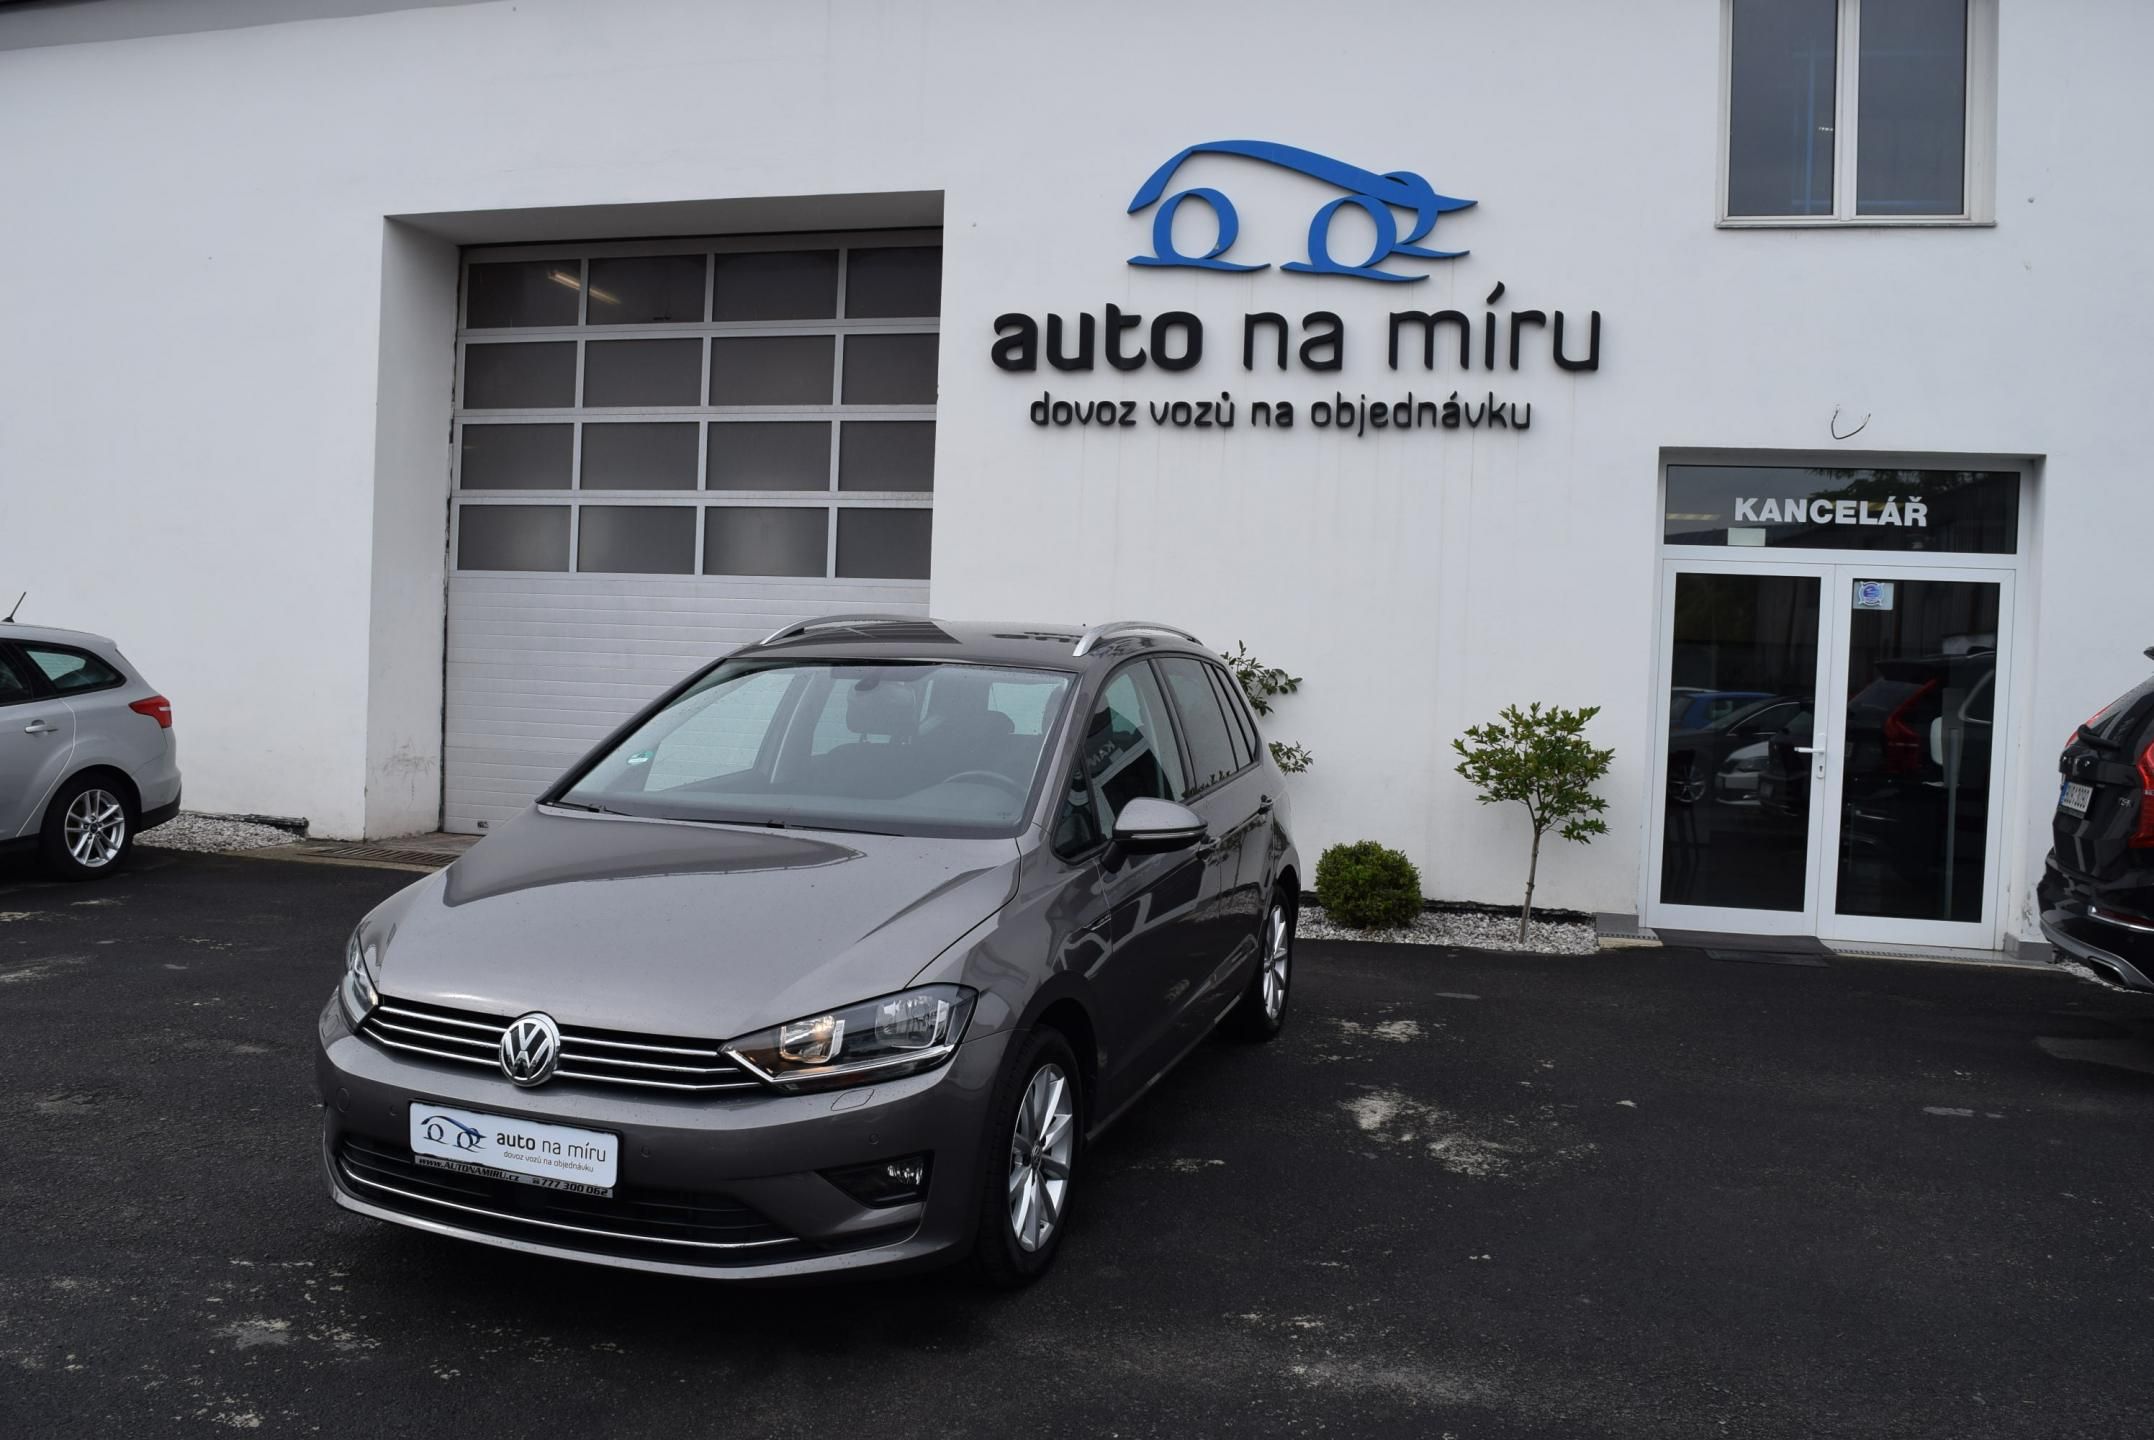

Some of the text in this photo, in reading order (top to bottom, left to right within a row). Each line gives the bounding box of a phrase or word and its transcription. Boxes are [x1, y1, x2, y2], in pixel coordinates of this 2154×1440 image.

[991, 281, 1600, 374] auto na míru
[1030, 391, 1531, 437] dovoz vozů na objednávku
[1734, 496, 1928, 528] KANCELÁŘ
[496, 1132, 606, 1163] auto na míru
[503, 1151, 594, 1172] dovoz vozů na objednávku
[418, 1157, 520, 1182] www.AUTONAMIRU.cz
[541, 1178, 560, 1189] 777
[565, 1183, 584, 1193] 300
